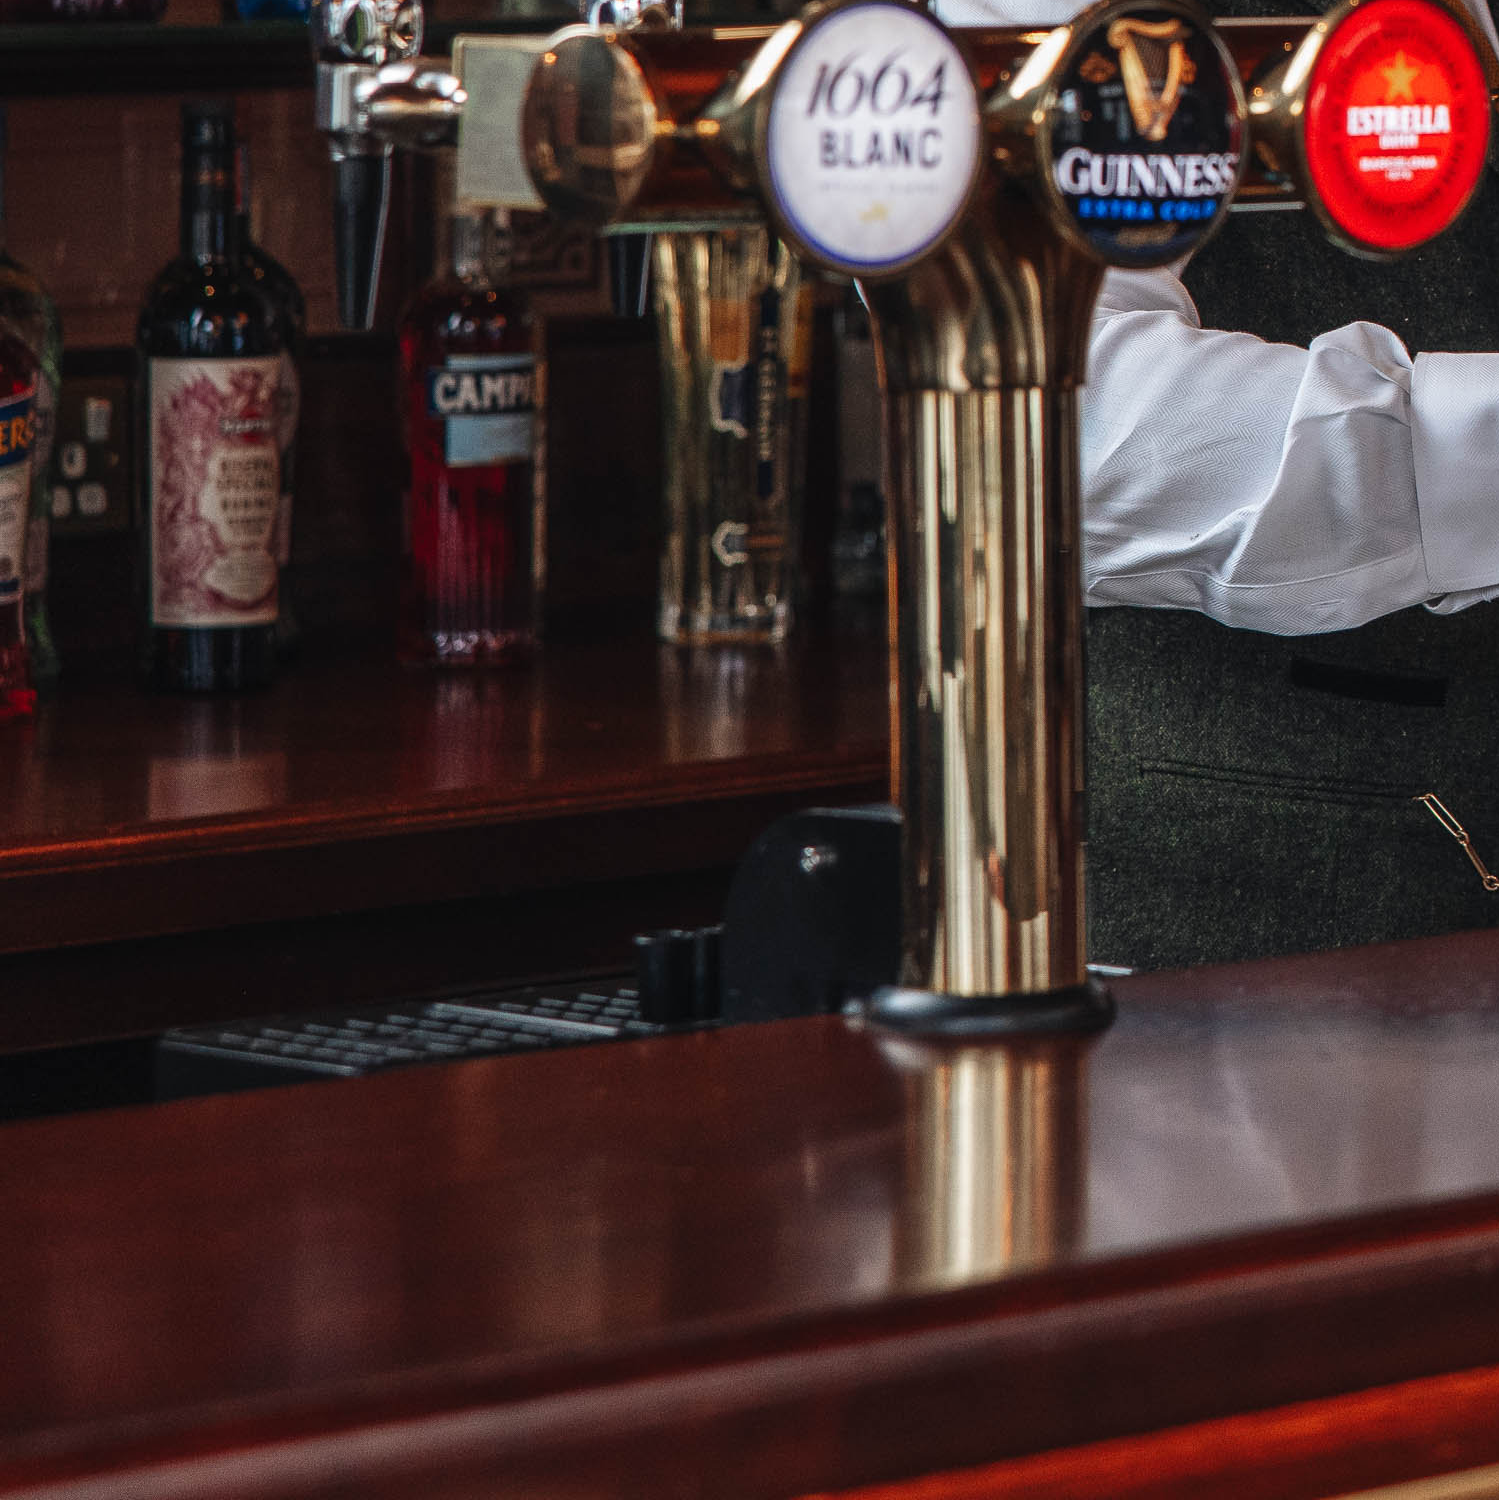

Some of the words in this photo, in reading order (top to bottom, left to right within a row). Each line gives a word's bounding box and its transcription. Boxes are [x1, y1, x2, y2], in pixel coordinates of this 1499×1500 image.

[806, 48, 949, 119] 1664
[1346, 106, 1451, 135] ESTRELLA
[820, 127, 943, 170] BLANC
[1057, 148, 1240, 197] GUINNESS
